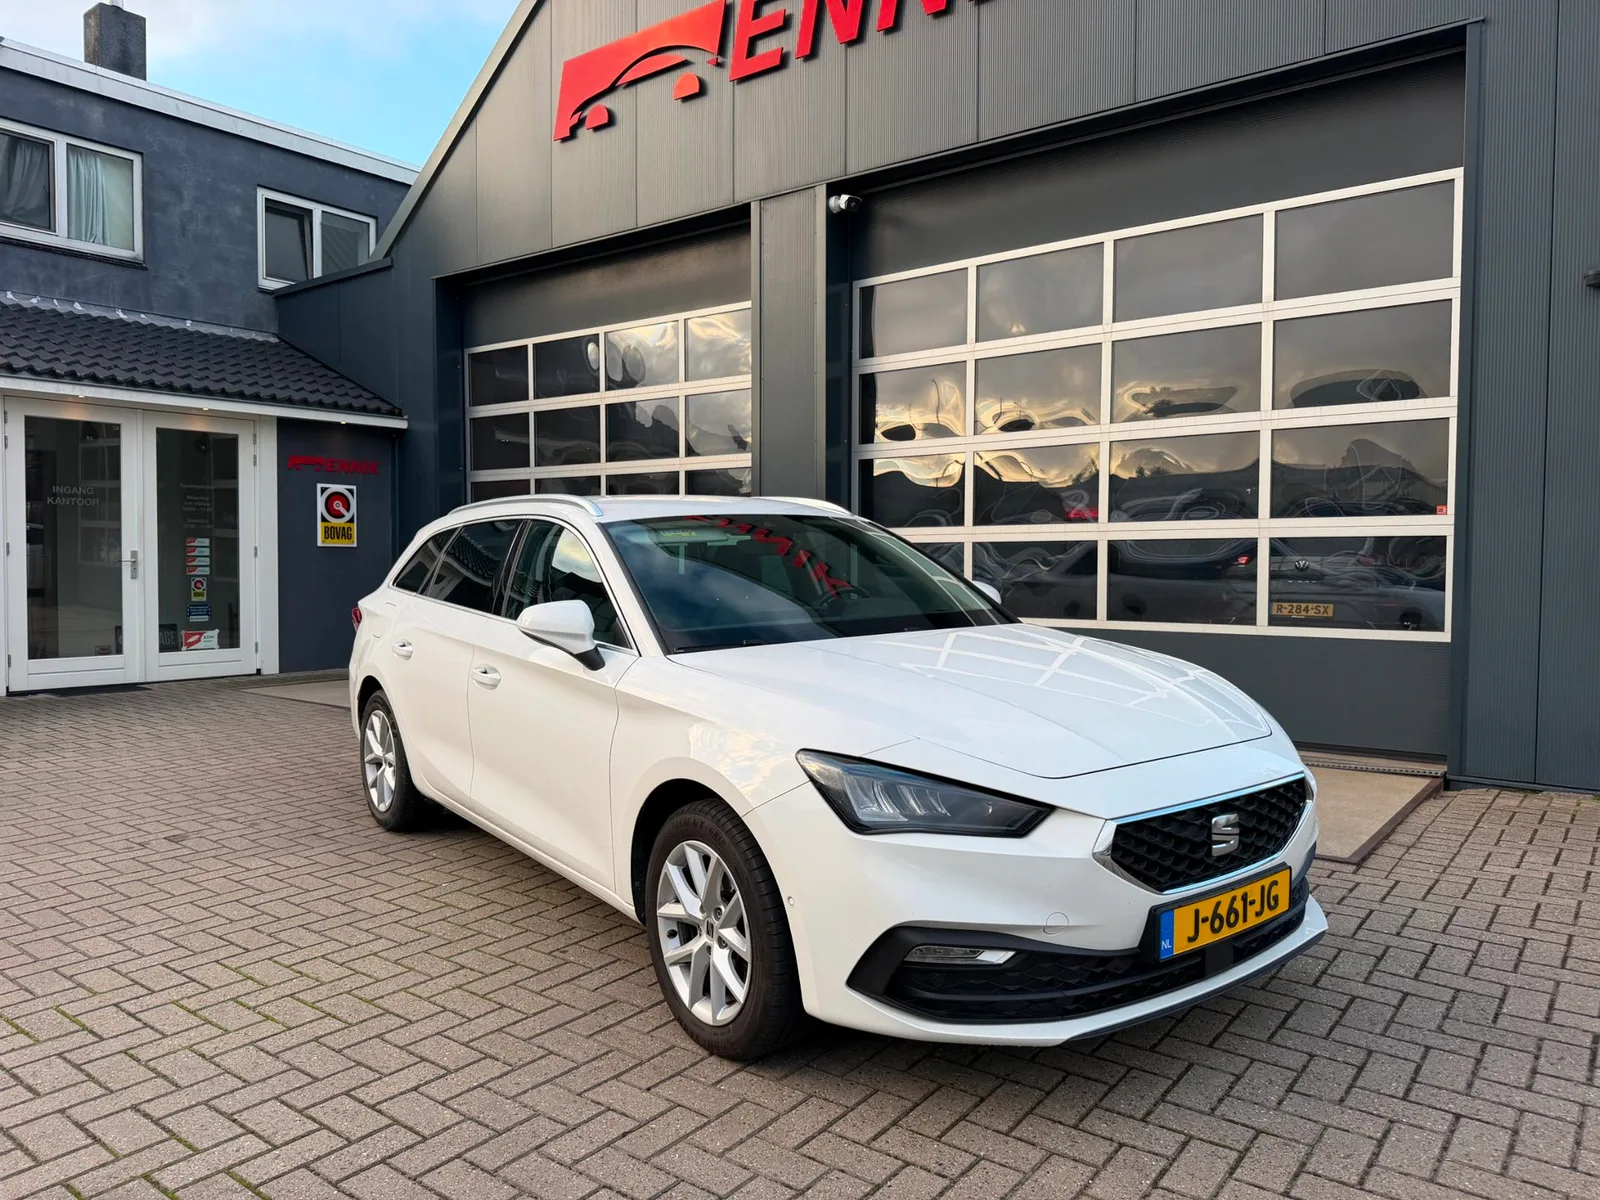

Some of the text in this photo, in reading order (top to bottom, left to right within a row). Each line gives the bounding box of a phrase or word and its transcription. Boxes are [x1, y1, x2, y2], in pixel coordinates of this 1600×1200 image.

[52, 485, 94, 495] INGANG
[47, 496, 99, 506] KANTOOR
[324, 525, 352, 540] BOVAG
[1276, 603, 1330, 616] R-284-SX
[1187, 880, 1279, 944] J-661-JG
[1161, 938, 1173, 951] NL
